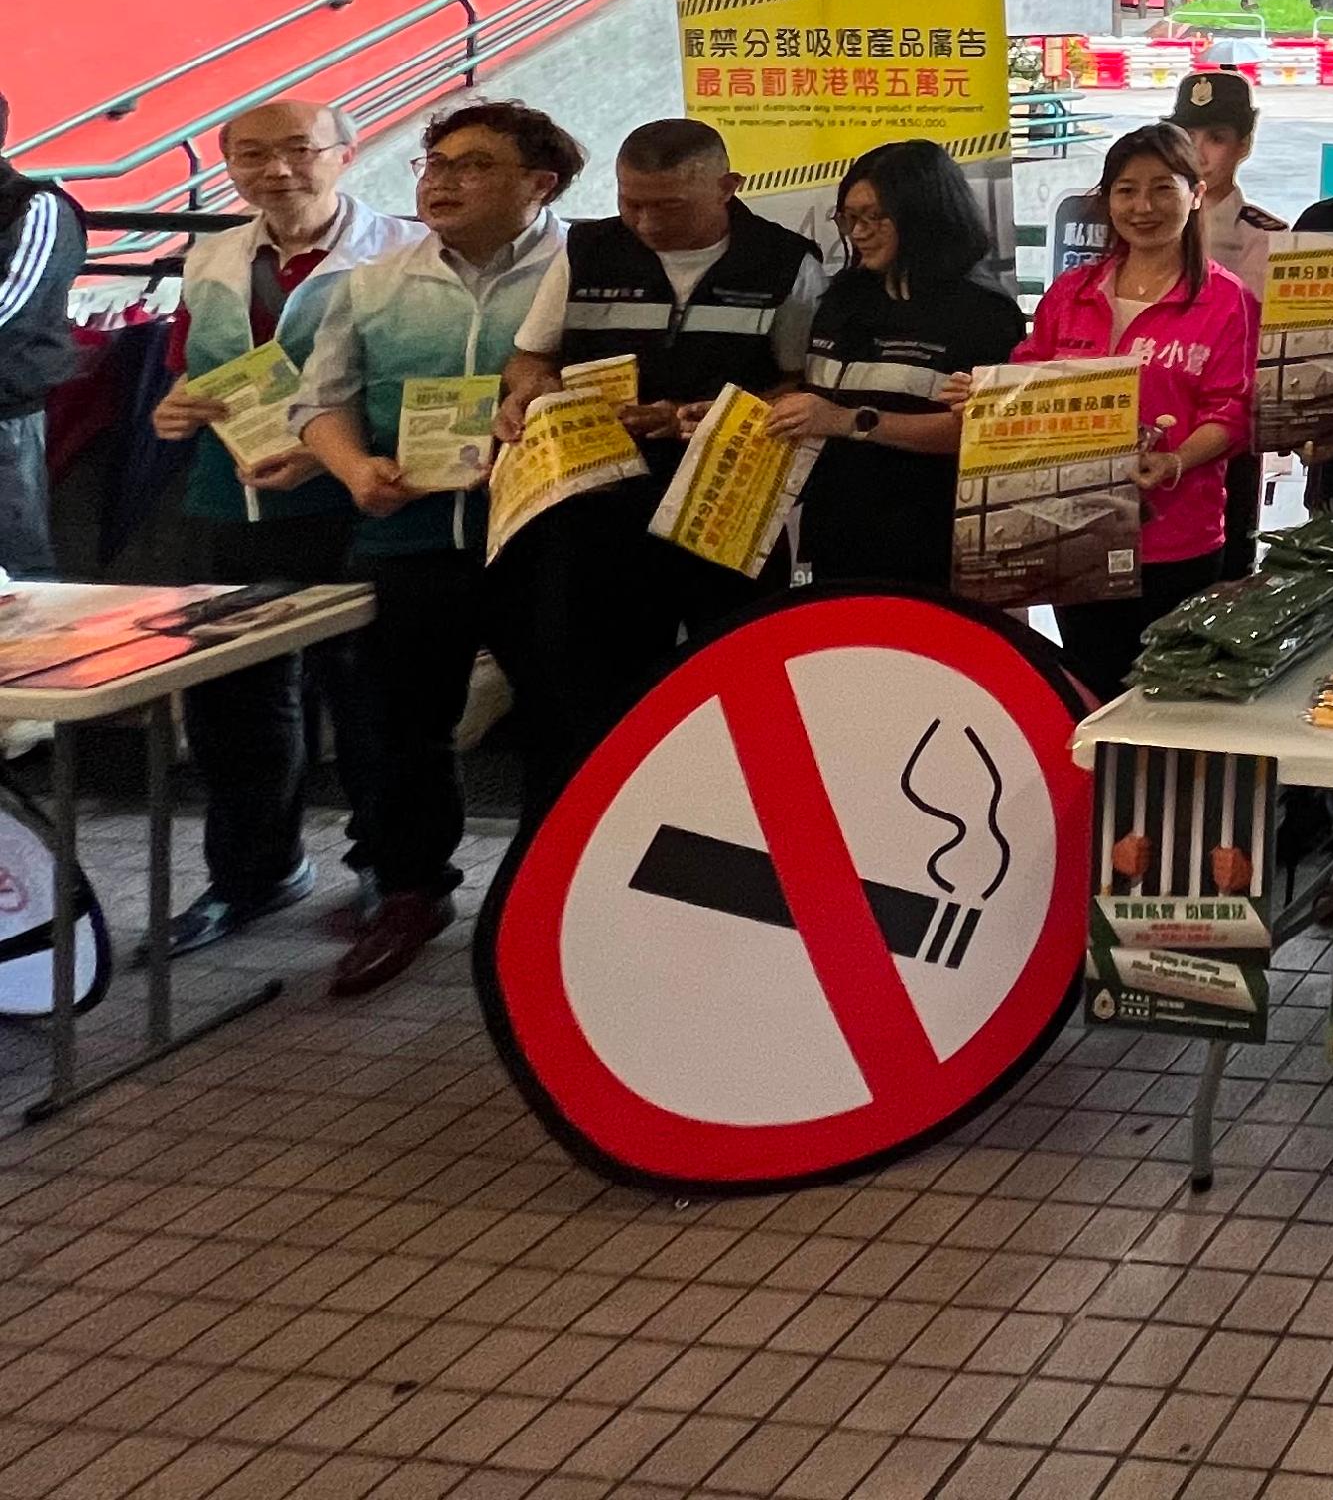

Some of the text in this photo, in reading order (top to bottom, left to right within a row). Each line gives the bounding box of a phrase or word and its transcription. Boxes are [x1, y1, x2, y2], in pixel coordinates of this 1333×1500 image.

[696, 67, 971, 98] 最高罰款港幣五萬元
